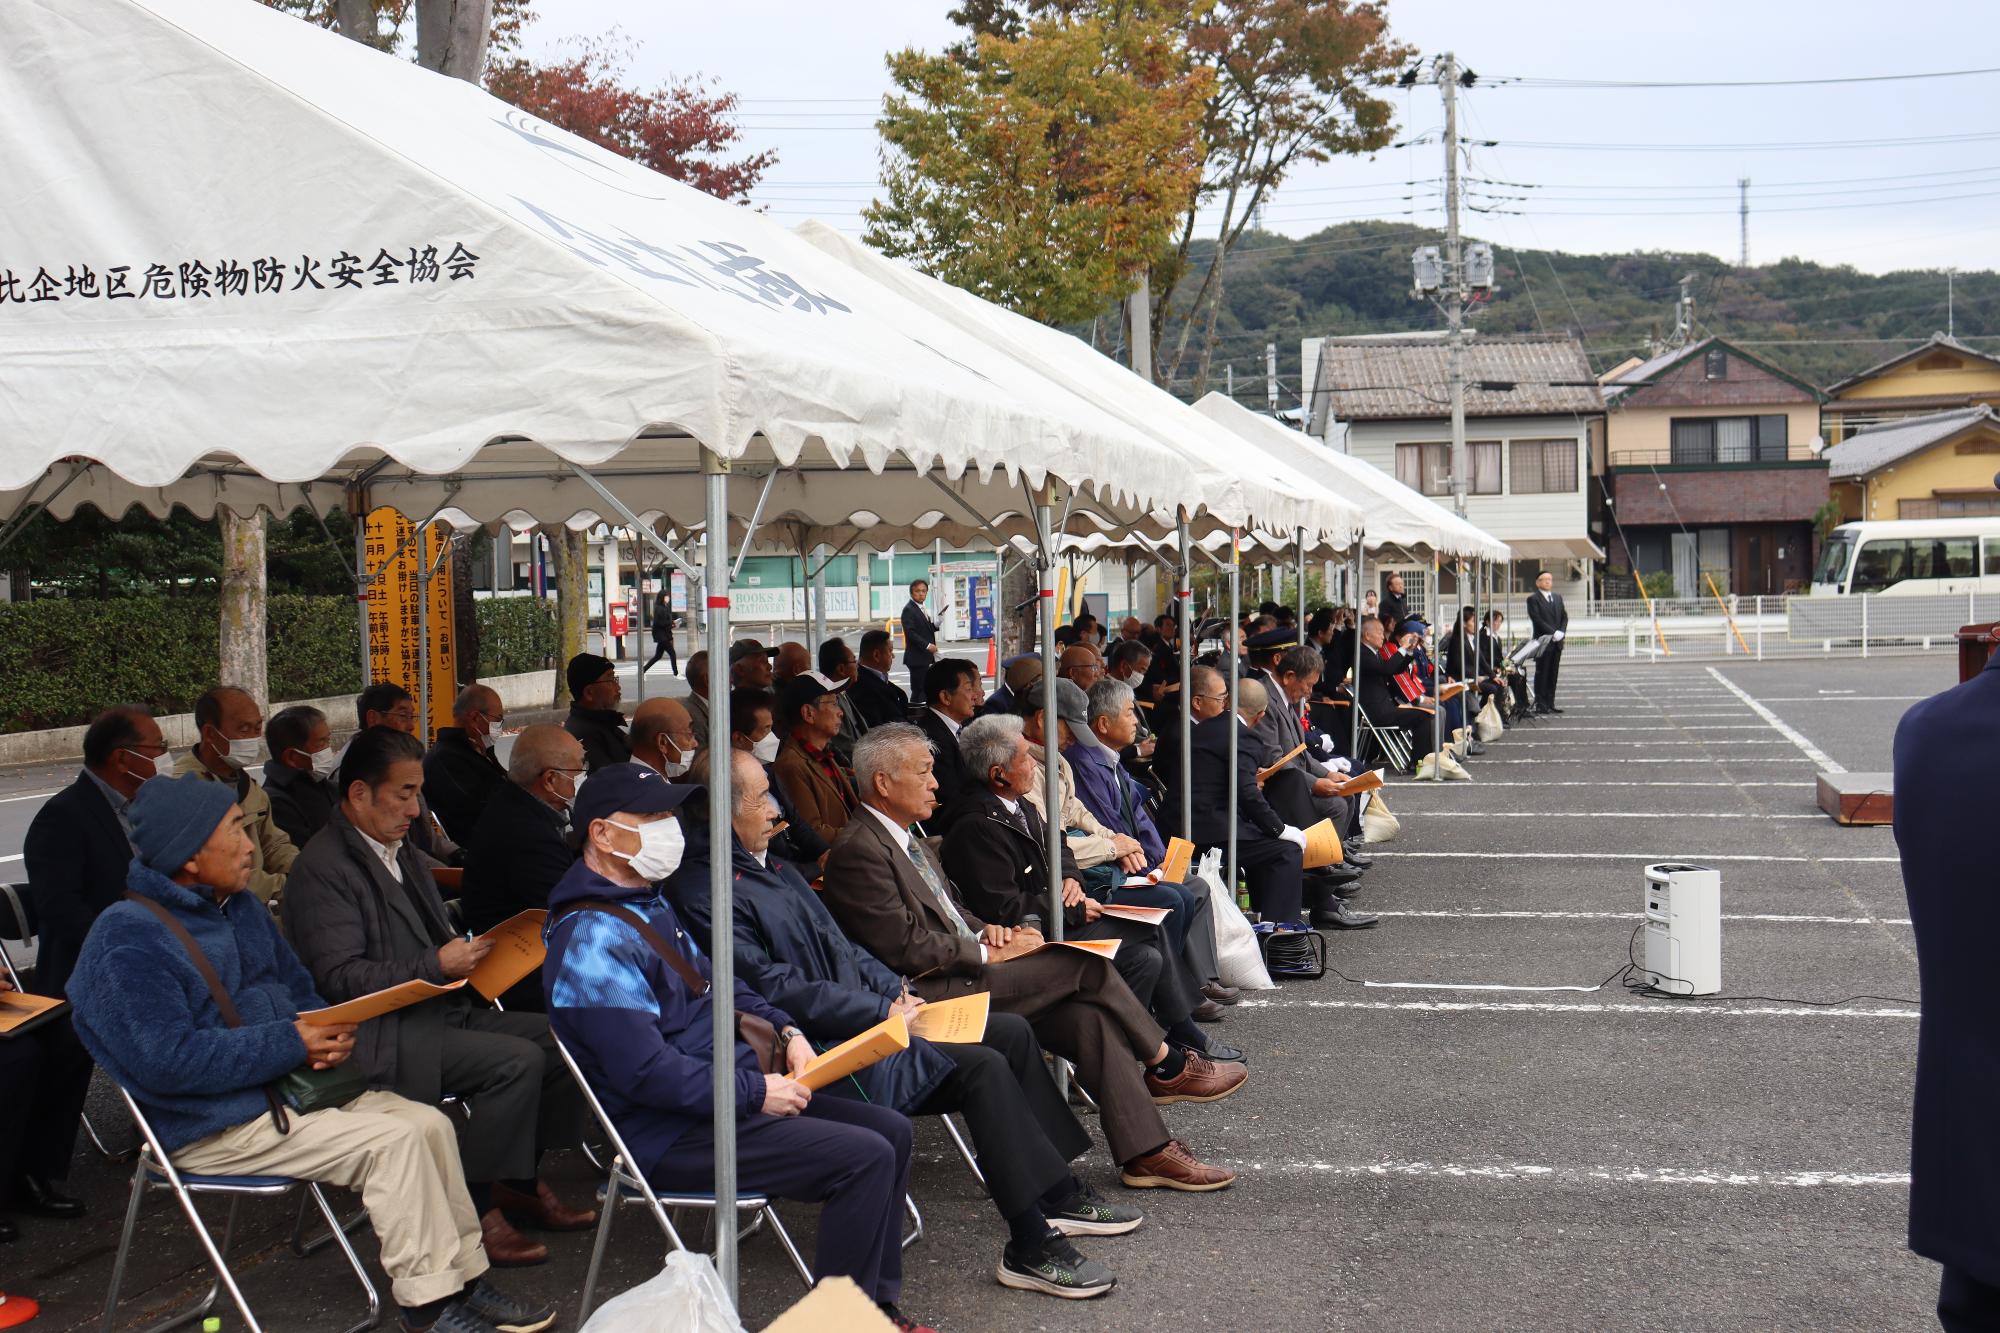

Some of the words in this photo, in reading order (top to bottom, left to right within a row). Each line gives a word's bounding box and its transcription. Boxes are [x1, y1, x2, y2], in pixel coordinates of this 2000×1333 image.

[0, 241, 480, 304] 比企地区危険物防火安全協会
[735, 592, 774, 603] BOOKS
[735, 602, 785, 614] STATIONERY
